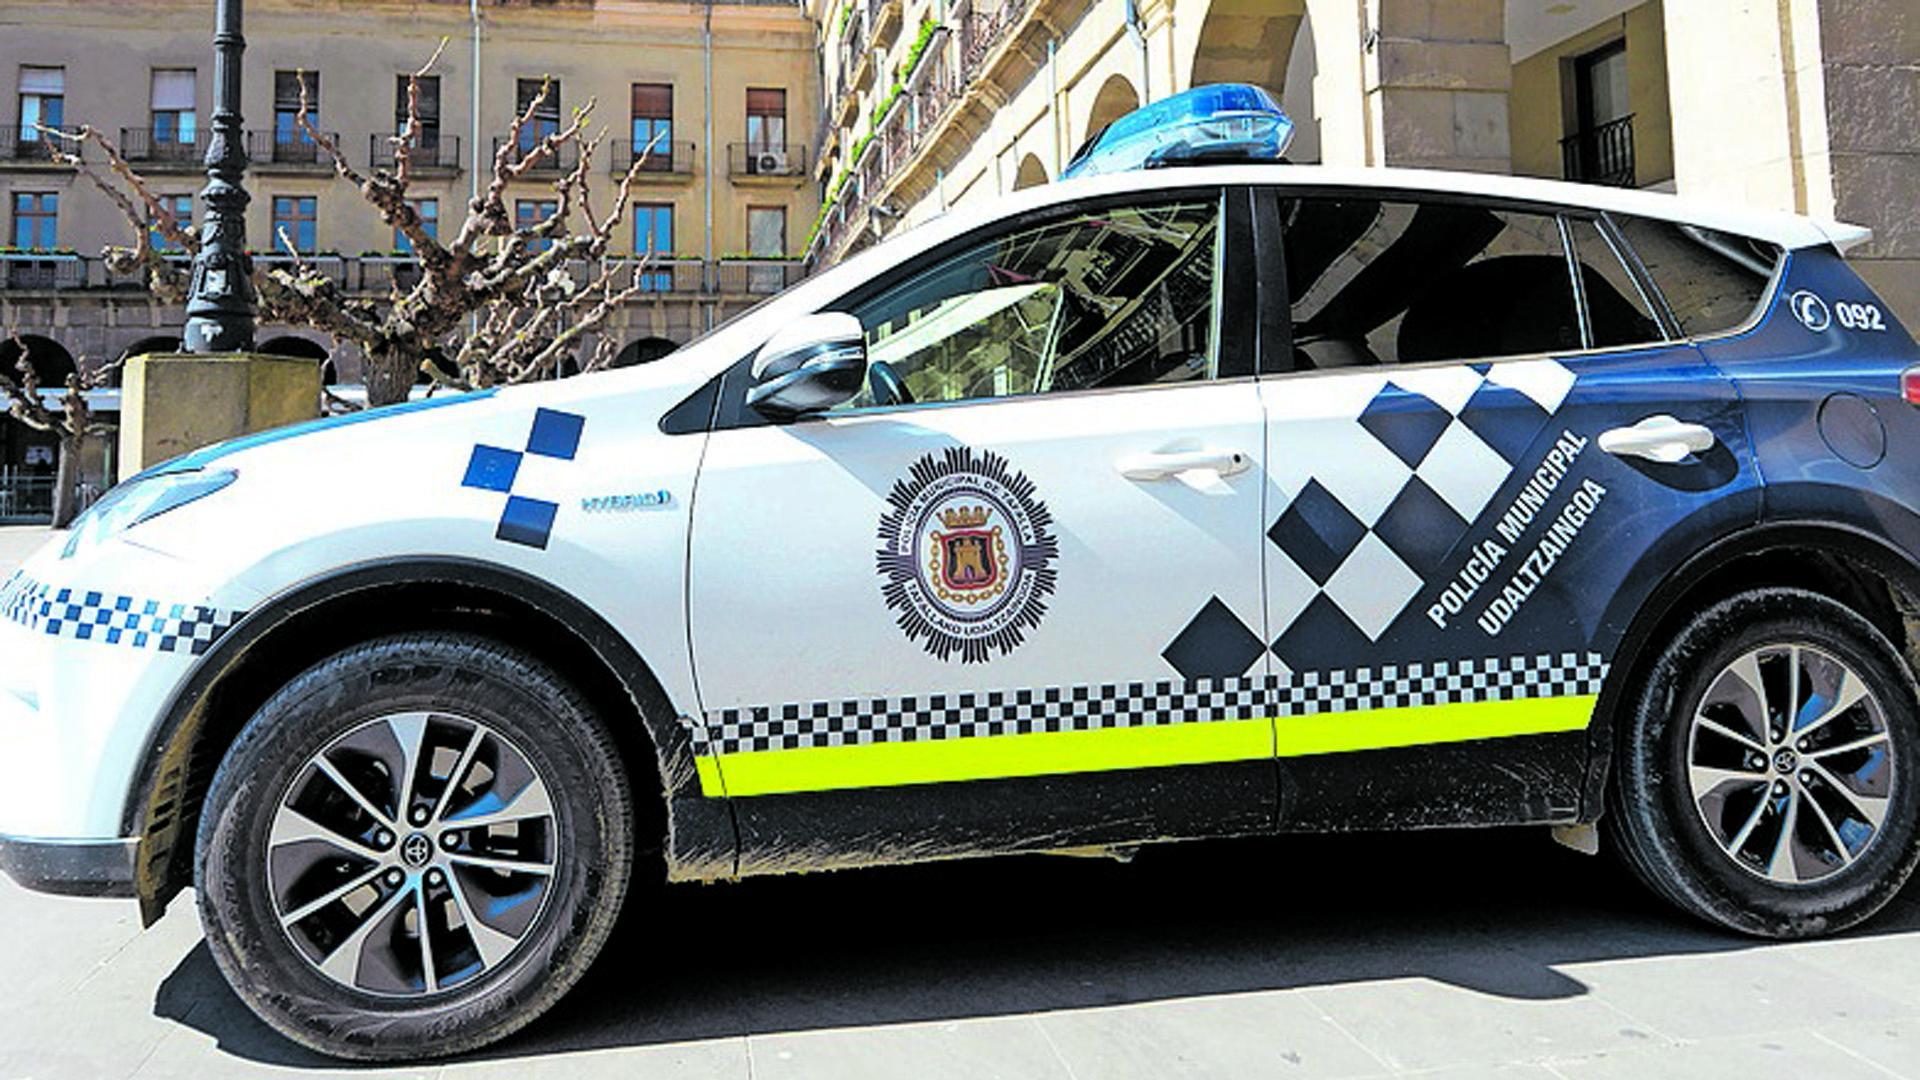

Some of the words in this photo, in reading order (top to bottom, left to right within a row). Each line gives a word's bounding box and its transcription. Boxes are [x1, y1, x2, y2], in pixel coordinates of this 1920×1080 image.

[1835, 301, 1886, 331] 092
[983, 481, 999, 493] DE
[1427, 544, 1508, 629] POLICÍA
[1496, 429, 1588, 544] MUNICIPAL
[1477, 478, 1607, 636] UDALTZAINGOA
